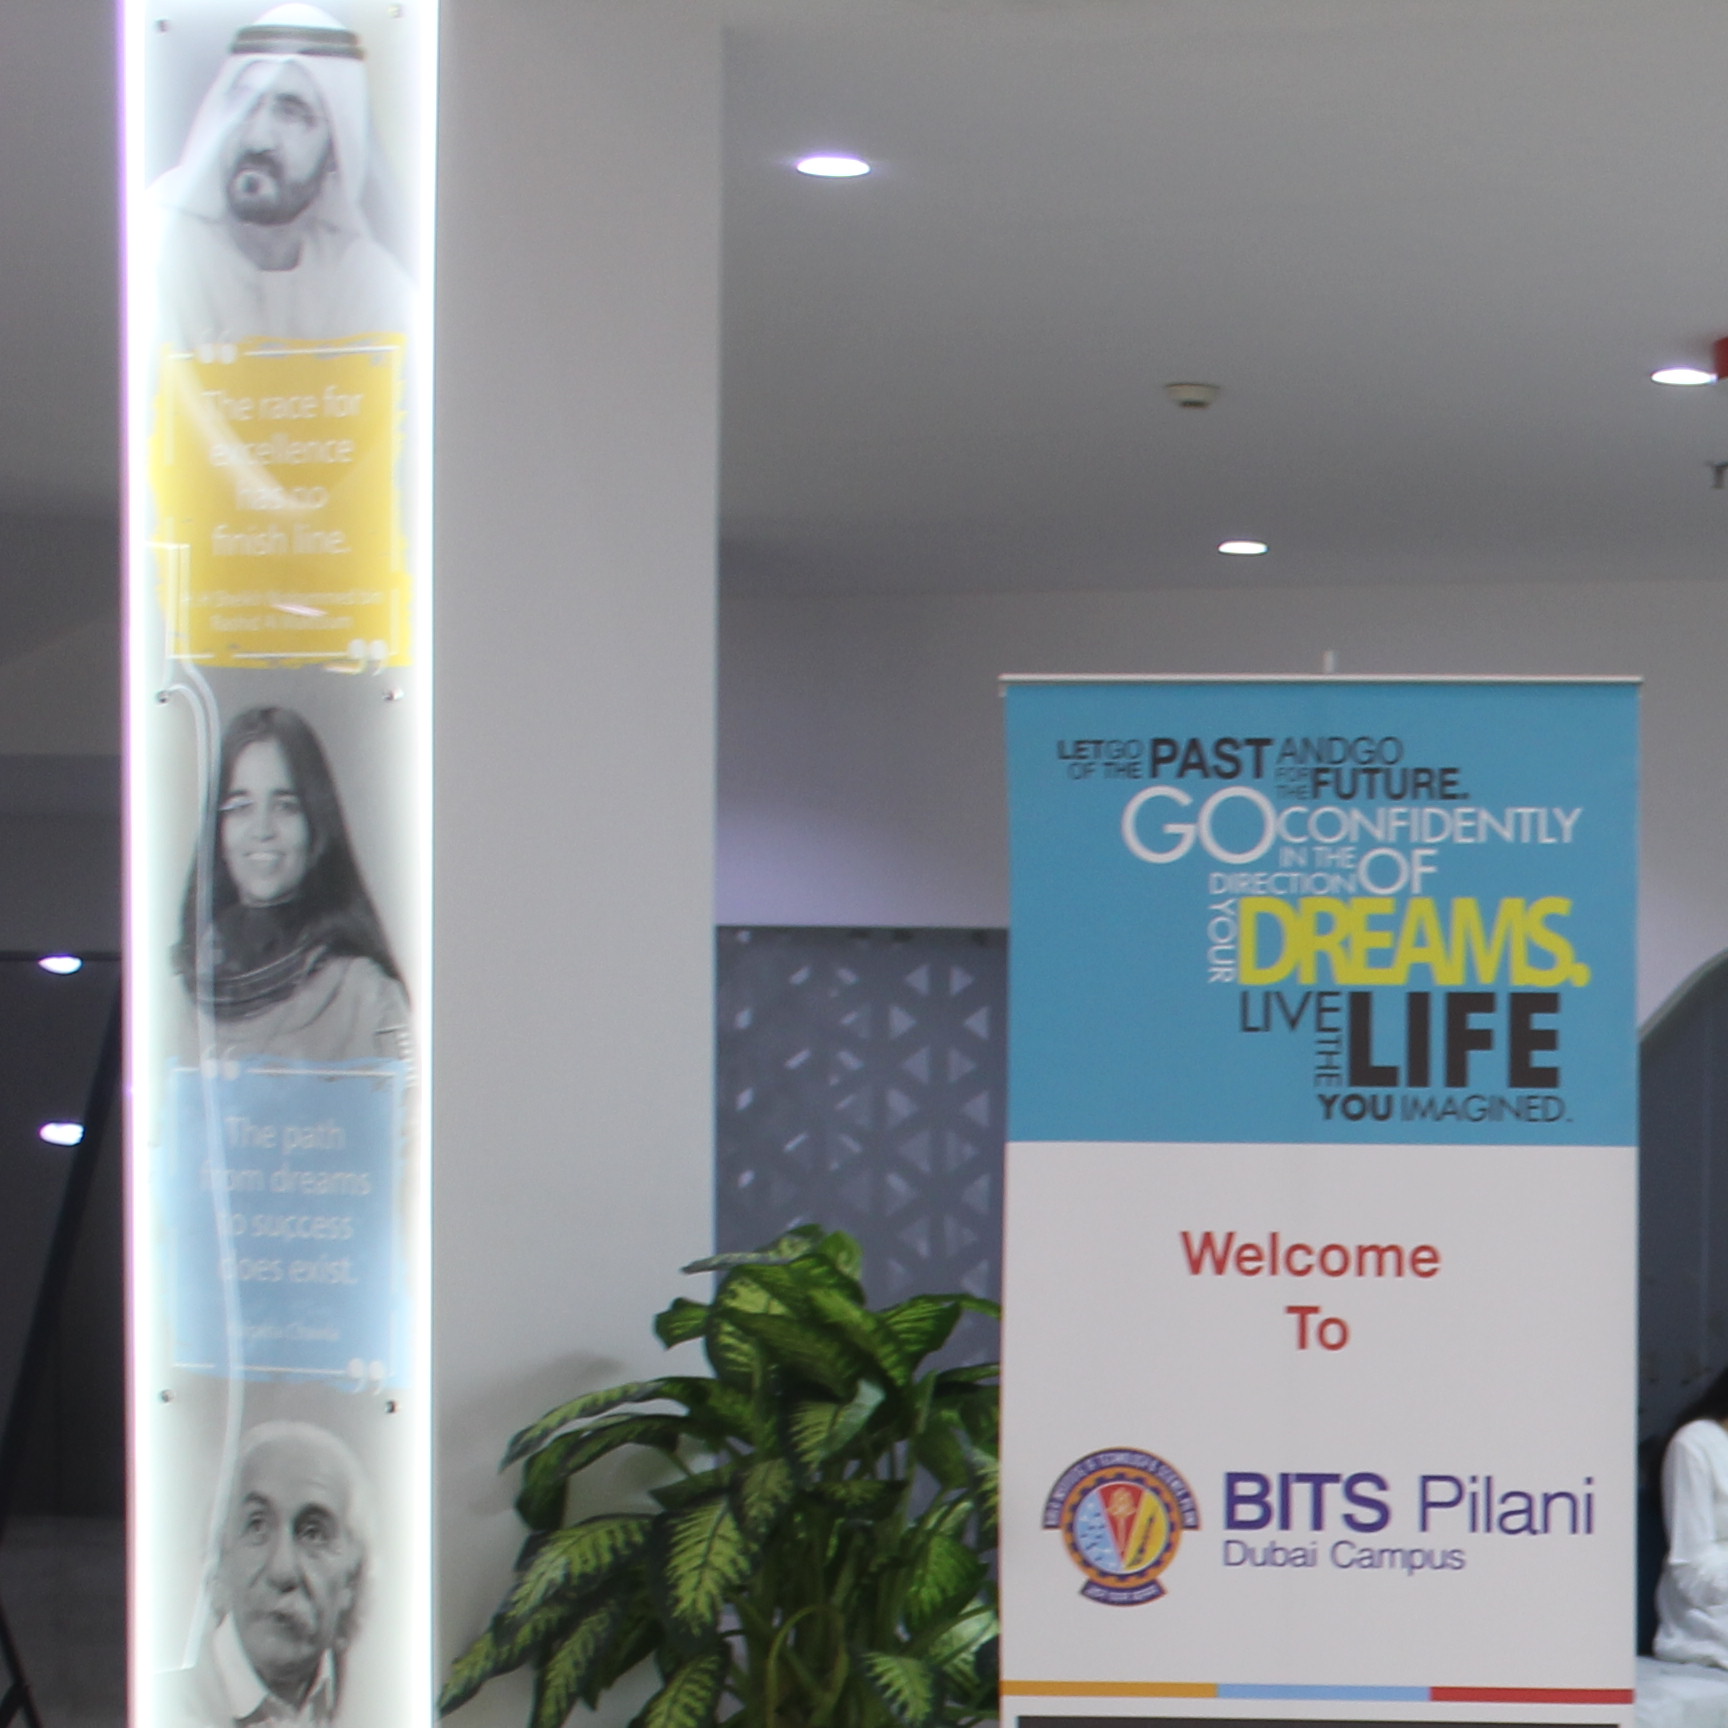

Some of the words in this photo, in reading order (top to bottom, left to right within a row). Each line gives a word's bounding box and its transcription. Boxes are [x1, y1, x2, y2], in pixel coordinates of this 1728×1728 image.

[258, 395, 318, 420] race
[323, 385, 365, 418] for
[210, 433, 355, 467] ecellence
[211, 523, 289, 556] finish
[1149, 736, 1275, 780] PAST
[1121, 785, 1278, 864] GO
[1277, 806, 1584, 844] CONFIDENTLY
[1208, 872, 1357, 896] DIRECTION
[1279, 847, 1308, 868] IN
[1313, 847, 1356, 869] THE
[1357, 847, 1440, 895] OF
[1207, 898, 1237, 985] YOUR
[1237, 896, 1592, 988] DREAMS.
[1240, 990, 1342, 1033] LIVE
[1348, 991, 1561, 1090] LIFE
[1315, 1033, 1343, 1088] THE
[1316, 1094, 1395, 1123] YOU
[223, 1114, 277, 1149] The
[281, 1118, 346, 1156] path
[269, 1161, 372, 1196] dreams
[251, 1213, 354, 1241] success
[1179, 1231, 1443, 1278] Welcome
[1285, 1304, 1351, 1352] To
[1223, 1470, 1392, 1534] BITS
[1418, 1472, 1597, 1537] Pilani
[1223, 1539, 1319, 1570] Dubai
[1330, 1539, 1467, 1577] Campus
